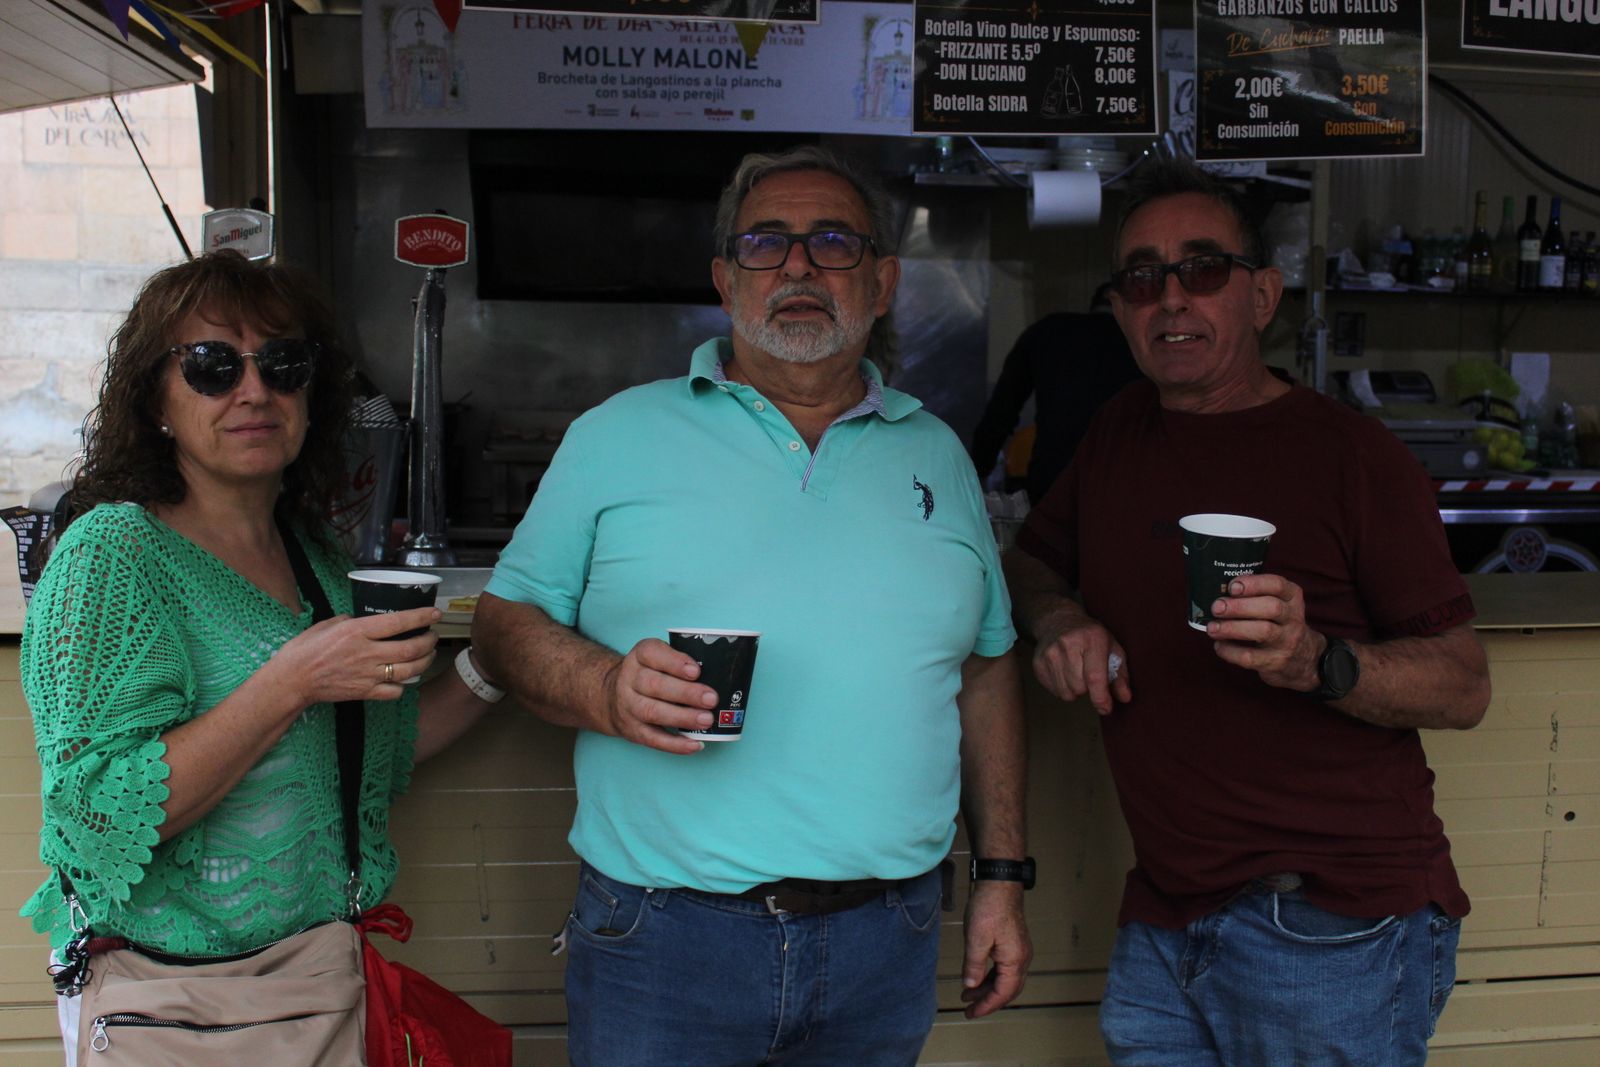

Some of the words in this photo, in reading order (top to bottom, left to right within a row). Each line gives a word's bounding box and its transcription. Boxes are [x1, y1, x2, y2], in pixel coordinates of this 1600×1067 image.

[1217, 0, 1304, 16] GARBANZOS
[1309, 0, 1338, 15] CON
[1344, 0, 1398, 14] CALLOS
[512, 14, 572, 33] FERIA
[924, 19, 973, 38] Botella
[976, 20, 1006, 39] Vino
[1010, 23, 1049, 40] Dulce
[1053, 27, 1061, 42] y
[1065, 25, 1141, 43] Espumoso:
[1339, 28, 1385, 45] PAELLA
[562, 46, 645, 68] MOLLY
[653, 47, 759, 70] MALONE
[934, 41, 1007, 61] -FRIZZANTE
[1094, 46, 1136, 64] 7,50€
[537, 72, 598, 86] Brocheta
[600, 73, 617, 85] de
[620, 73, 700, 89] Langostinos
[704, 78, 712, 87] a
[715, 75, 728, 87] la
[730, 76, 782, 90] plancha
[934, 63, 967, 81] -DON
[971, 65, 1027, 82] LUCIANO
[1094, 67, 1137, 85] 8,00€
[595, 89, 618, 98] con
[622, 88, 657, 99] salsa
[660, 89, 679, 101] ajo
[683, 89, 725, 102] perejil
[1234, 77, 1284, 101] 2,00€
[1341, 74, 1390, 98] 3,50€
[933, 93, 984, 112] Botella
[988, 94, 1028, 113] SIDRA
[1096, 96, 1138, 114] 7,50€
[1249, 102, 1269, 119] Sin
[1353, 100, 1377, 116] Con
[1217, 120, 1300, 140] Consumición
[1324, 119, 1406, 136] Consumición
[403, 228, 462, 251] BENDITO
